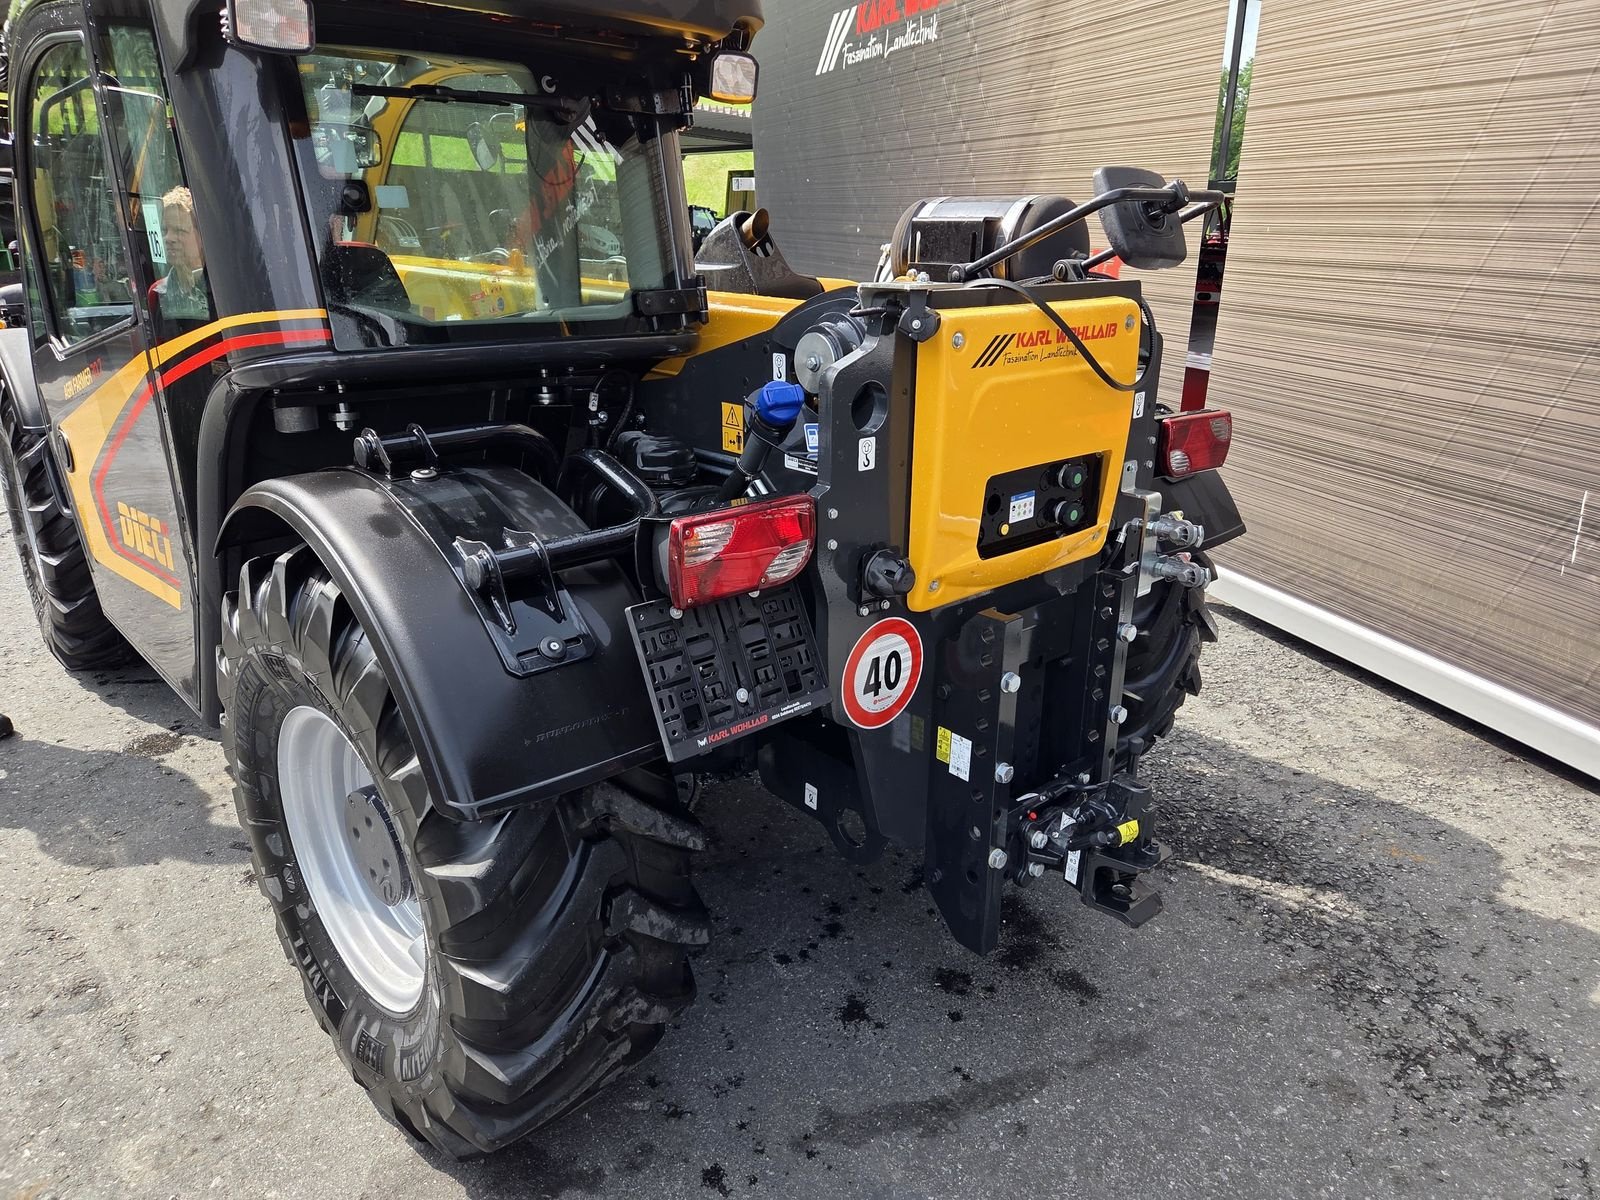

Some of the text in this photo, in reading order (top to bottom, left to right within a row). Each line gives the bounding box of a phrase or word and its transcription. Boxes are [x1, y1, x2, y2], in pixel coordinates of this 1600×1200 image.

[842, 14, 938, 69] Faszination Landtechnik
[1016, 330, 1052, 348] KARL
[1003, 350, 1039, 367] Faszination
[863, 650, 902, 697] 40
[708, 729, 729, 744] KARL
